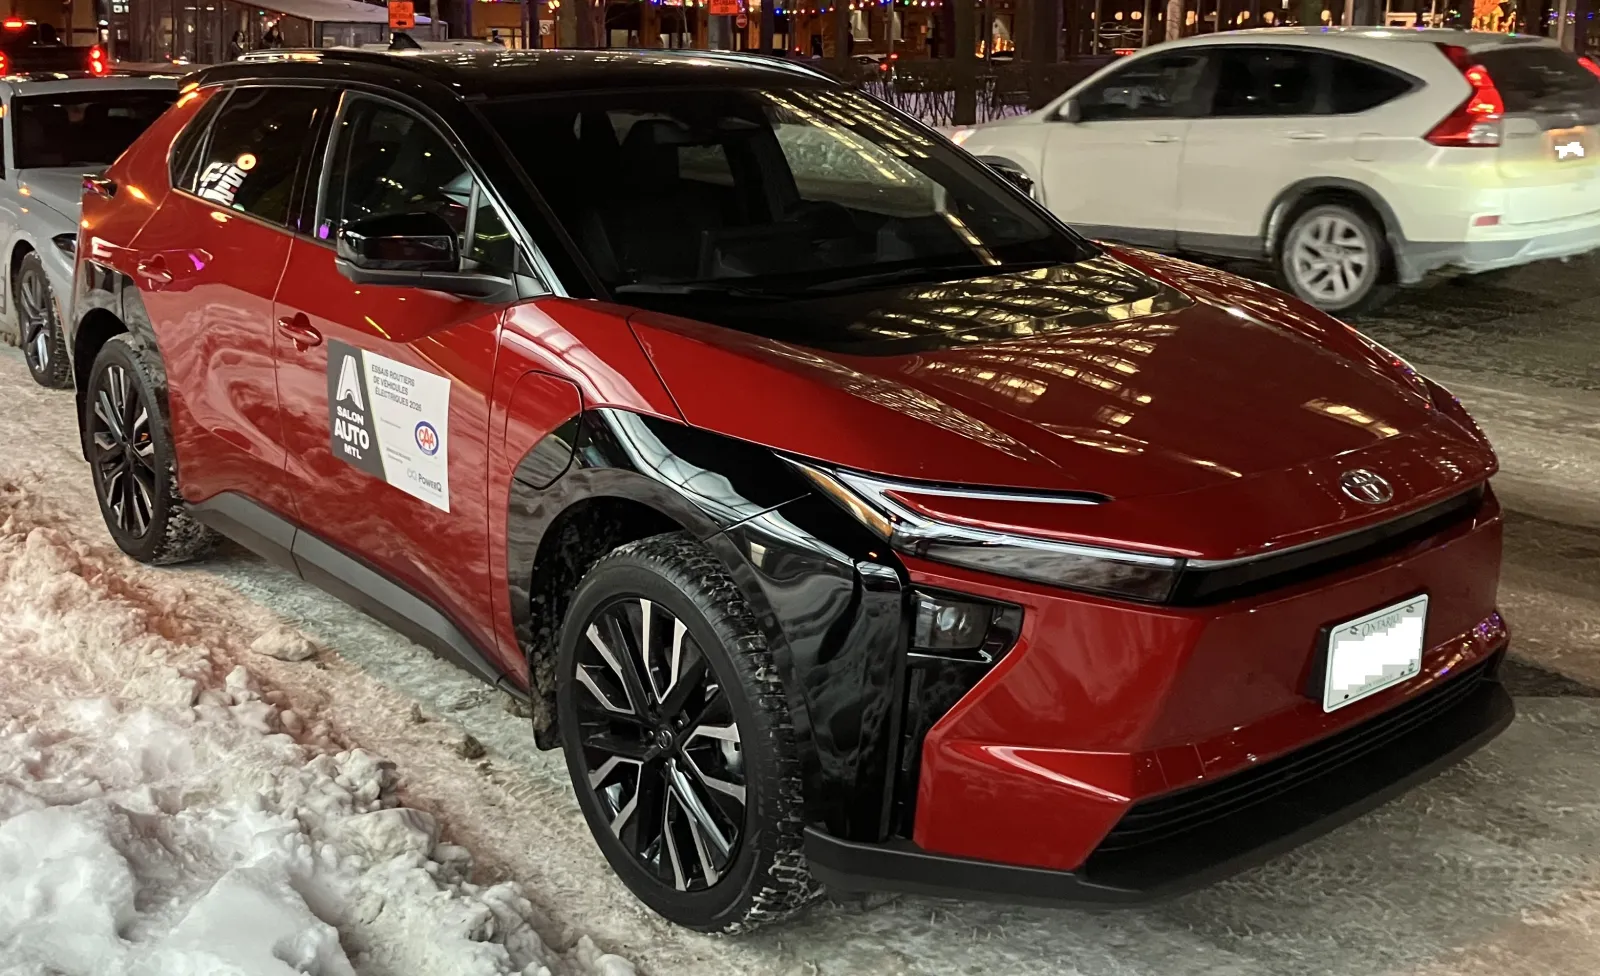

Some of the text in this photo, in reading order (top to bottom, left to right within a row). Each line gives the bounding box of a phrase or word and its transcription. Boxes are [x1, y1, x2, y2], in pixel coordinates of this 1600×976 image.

[371, 363, 415, 387] ESSAIS ROUTIERS
[373, 375, 380, 385] DE
[337, 405, 364, 426] SALON
[334, 418, 370, 450] AUTO
[419, 428, 434, 449] CAA
[344, 443, 362, 460] MTL
